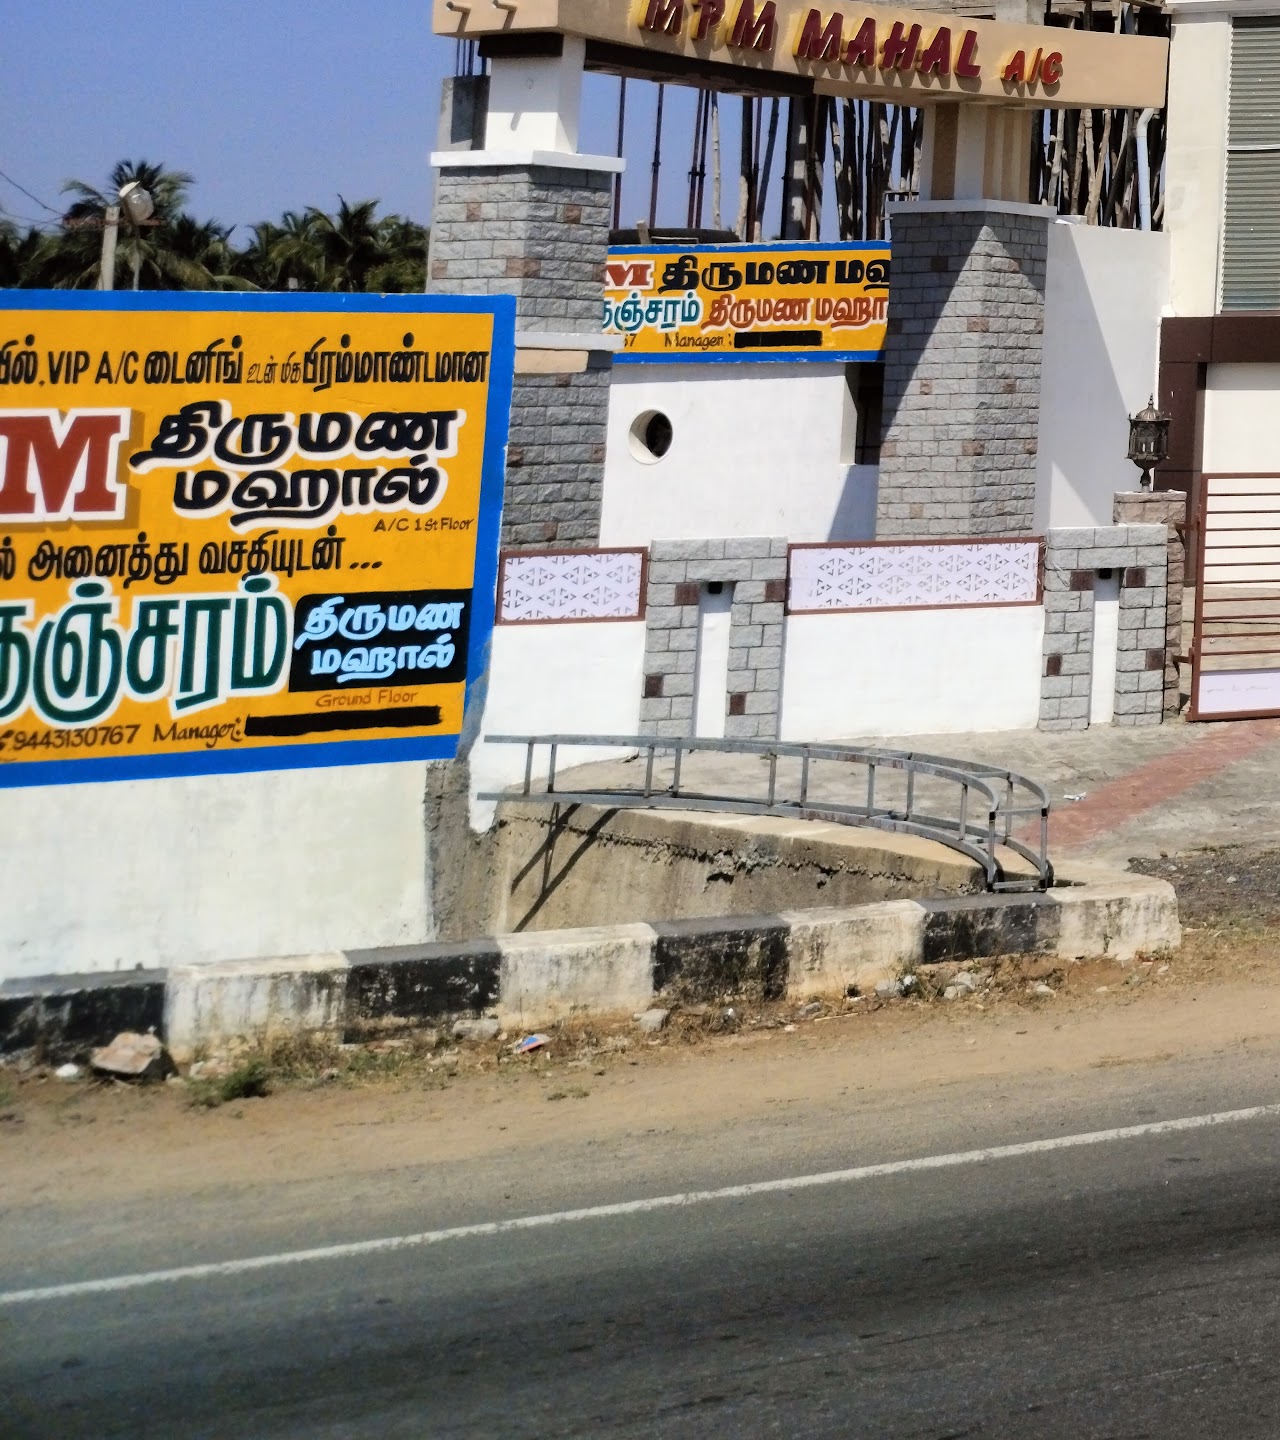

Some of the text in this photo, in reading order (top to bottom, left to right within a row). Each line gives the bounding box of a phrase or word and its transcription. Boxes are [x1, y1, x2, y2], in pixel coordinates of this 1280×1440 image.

[794, 8, 981, 78] MAHAL
[1002, 47, 1063, 85] A/C
[657, 254, 830, 295] திருமண
[602, 291, 889, 332] ஞ்சரம் திருமண மஹா
[48, 349, 91, 385] VIP
[94, 349, 140, 385] A/C
[143, 334, 245, 385] டைனிங்
[302, 331, 490, 393] பிரம்மாண்டமான
[128, 399, 459, 469] திருமண
[174, 454, 442, 528] மஹால்
[373, 517, 410, 532] A/C
[440, 516, 475, 531] Floor
[28, 530, 190, 590] அனைத்து
[293, 596, 466, 651] திருமண
[309, 632, 456, 684] மஹால்
[315, 688, 420, 709] Ground Floor
[13, 723, 142, 752] 9443130767
